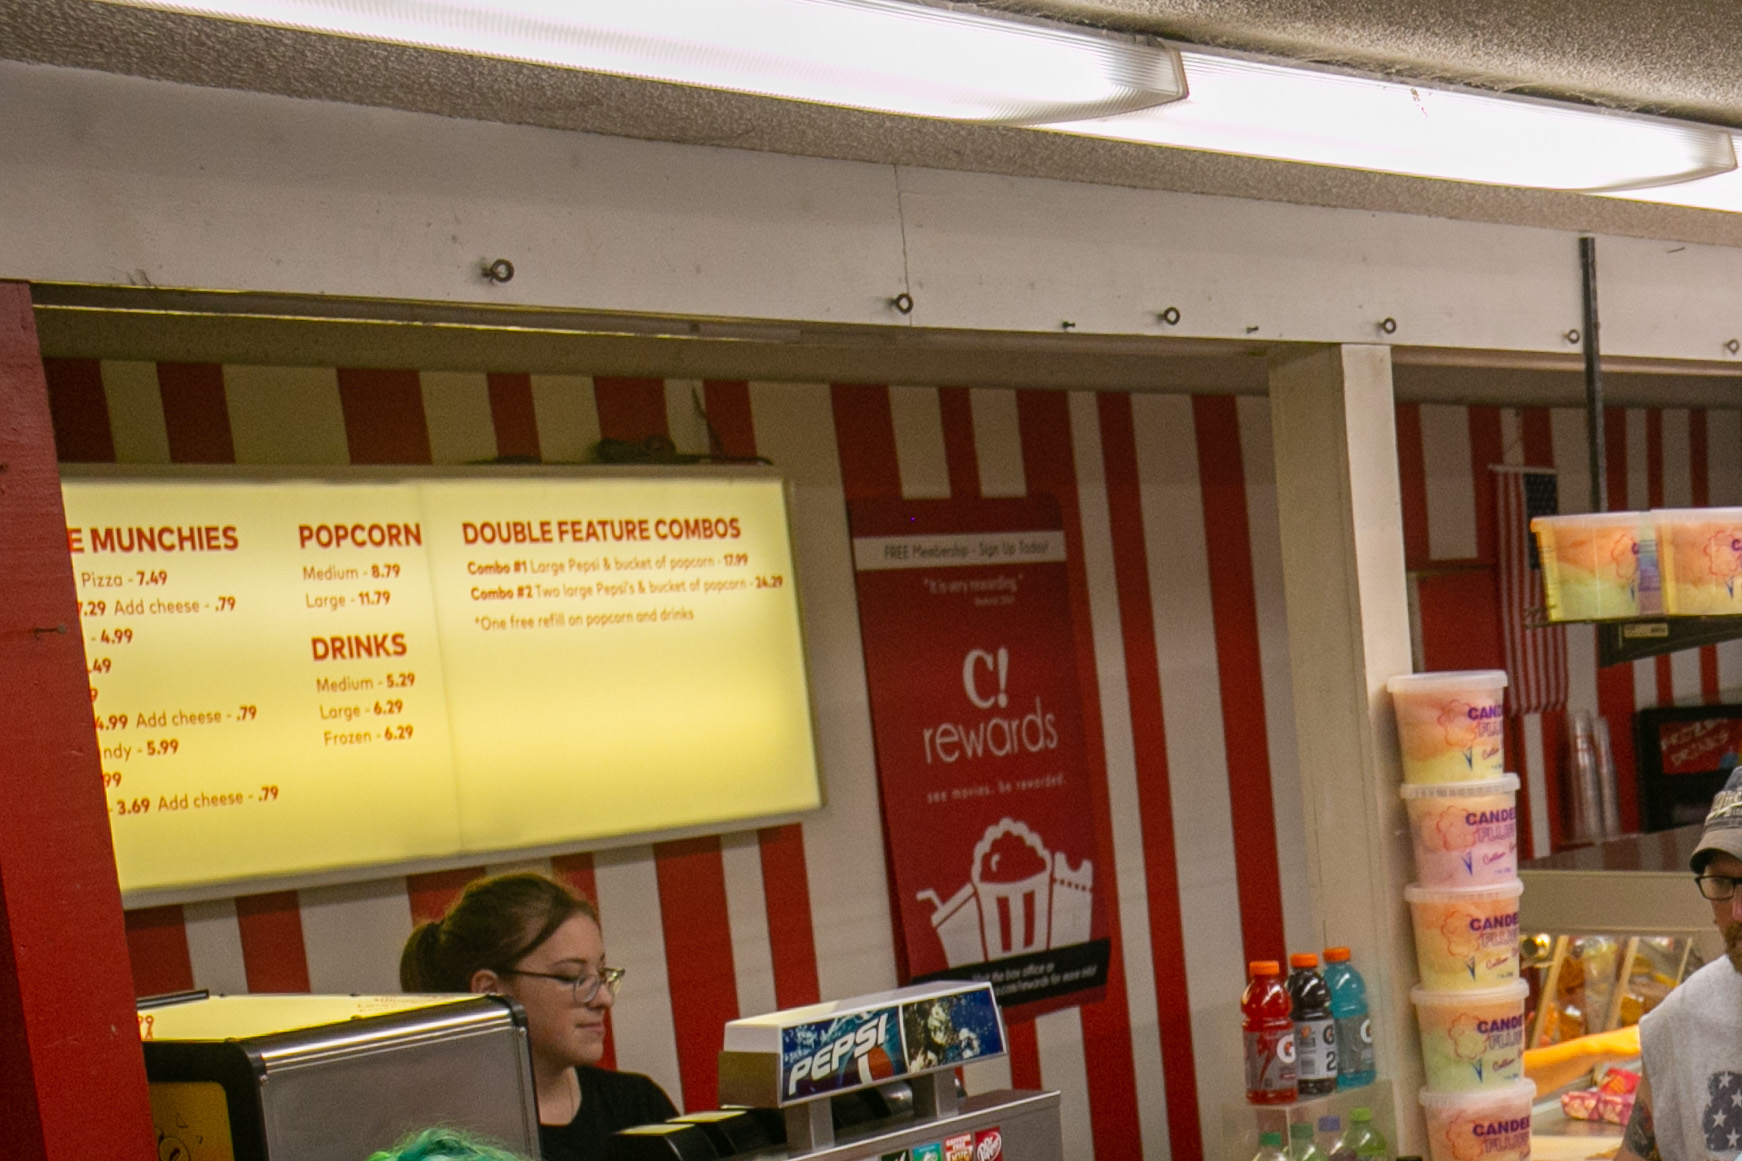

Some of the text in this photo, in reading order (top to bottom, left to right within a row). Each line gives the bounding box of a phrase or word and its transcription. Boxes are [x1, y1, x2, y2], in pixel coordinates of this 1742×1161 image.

[91, 526, 239, 552] MUNCHIES
[299, 523, 422, 548] POPCORN
[462, 518, 741, 544] DOUBLE FEATURE COMBOS
[884, 546, 908, 559] FREE
[303, 564, 400, 581] Medium 8.79
[468, 561, 510, 576] Combo
[514, 561, 528, 573] #1
[530, 559, 565, 576] Large
[569, 558, 600, 575] Pepsi
[603, 559, 611, 570] &
[614, 557, 652, 571] bucket
[656, 555, 666, 569] of
[670, 554, 714, 569] popcorn
[82, 571, 167, 588] Pizza 7.49
[471, 586, 514, 601] Combo
[517, 585, 533, 599] #2
[535, 585, 560, 598] Two
[563, 583, 592, 600] large
[596, 581, 634, 598] Pepsi's
[638, 582, 645, 594] &
[649, 579, 686, 594] bucket
[690, 579, 700, 592] of
[704, 577, 746, 594] popcorn
[114, 600, 144, 615] Add
[150, 600, 200, 614] cheese
[215, 597, 236, 612] .79
[305, 591, 390, 611] Large 11.79
[510, 614, 534, 630] free
[538, 612, 565, 628] refill
[569, 613, 583, 627] on
[586, 610, 633, 628] popcorn
[637, 608, 657, 623] and
[661, 607, 694, 622] drinks
[101, 629, 133, 645] 4.99
[312, 633, 407, 661] DRINKS
[317, 673, 415, 693] Medium 5.29
[136, 713, 166, 728] Add
[172, 711, 221, 726] cheese
[236, 705, 257, 722] .79
[320, 700, 403, 722] Large 6.29
[324, 725, 413, 746] Frozen 6.29
[923, 696, 1058, 764] rewards
[147, 739, 179, 756] 5.99
[117, 785, 279, 815] 3.69 Add cheese .79
[787, 1013, 887, 1096] PEPSI
[1326, 1051, 1337, 1072] 2
